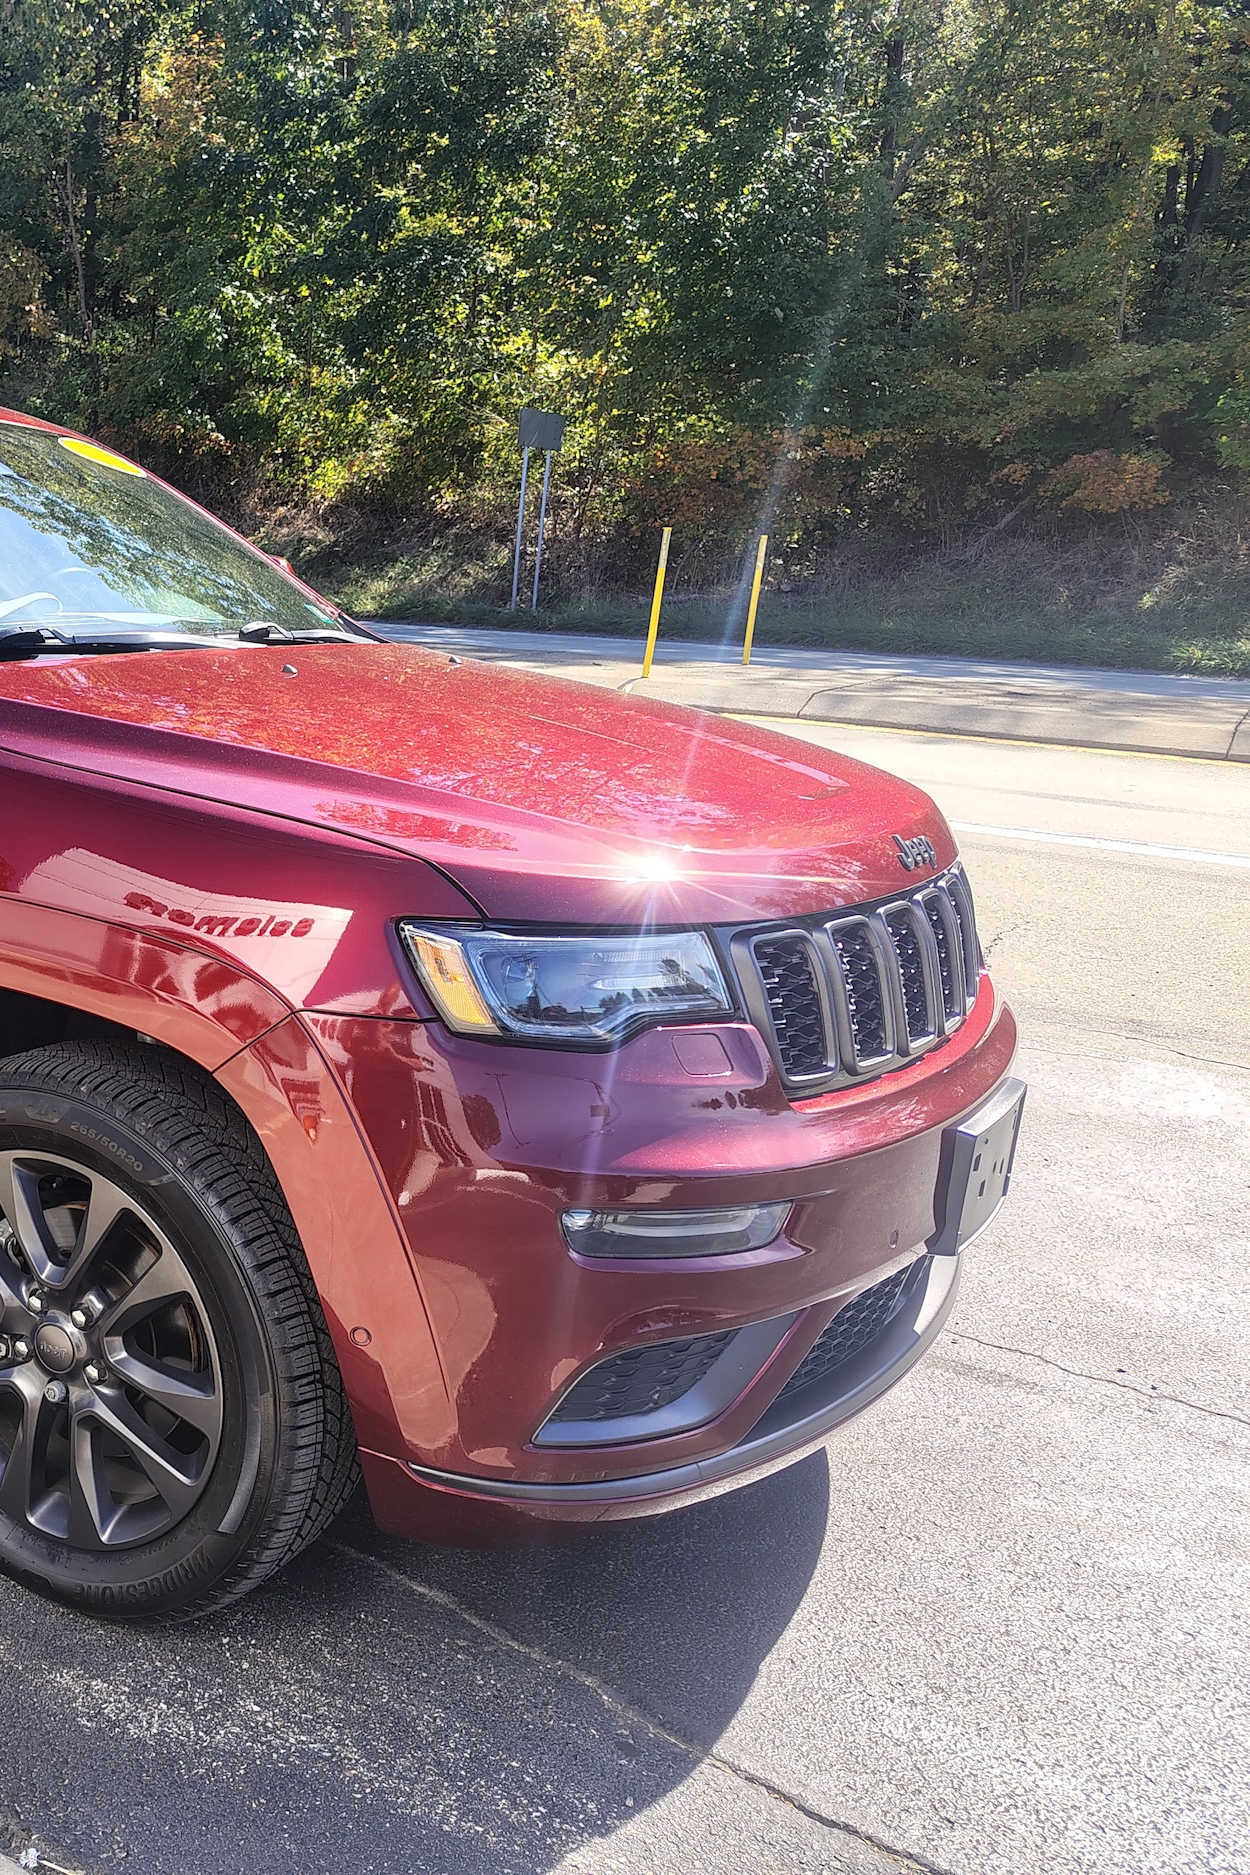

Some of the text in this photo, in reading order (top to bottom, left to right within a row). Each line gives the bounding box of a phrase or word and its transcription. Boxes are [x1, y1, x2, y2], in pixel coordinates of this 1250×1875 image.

[892, 833, 937, 872] Jeep
[69, 1120, 144, 1173] 265/50R20
[40, 1340, 69, 1360] Jeep
